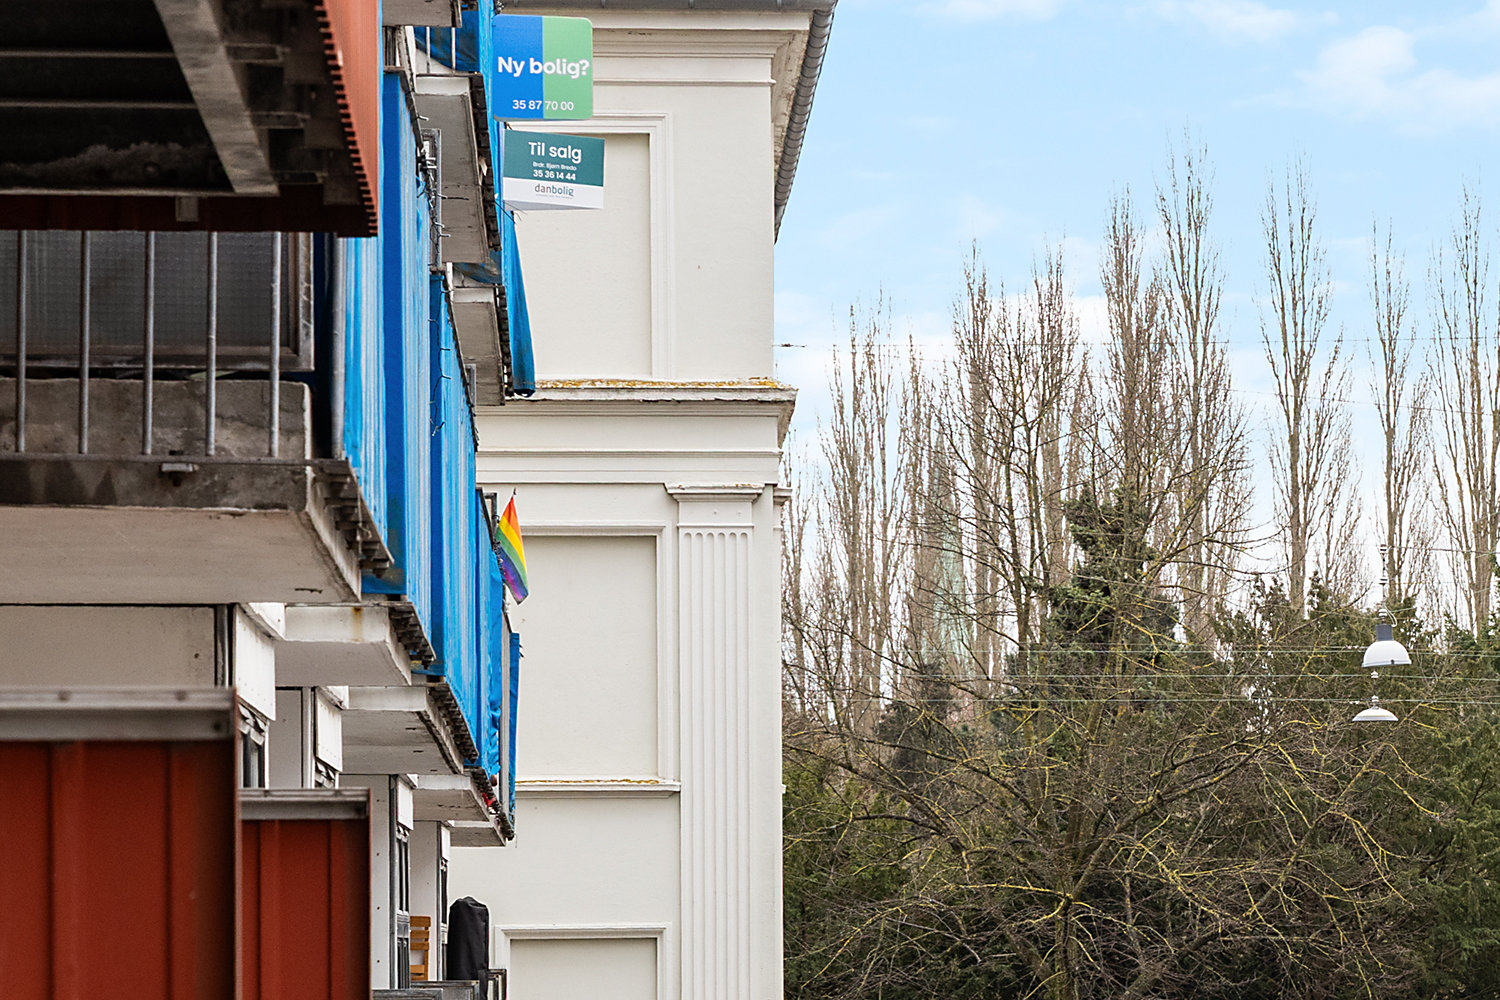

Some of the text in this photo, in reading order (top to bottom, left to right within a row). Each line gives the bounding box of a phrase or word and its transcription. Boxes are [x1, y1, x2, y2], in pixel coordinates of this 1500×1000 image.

[497, 56, 590, 79] Ny bolig?
[512, 100, 574, 111] 35 87 70 00
[528, 141, 582, 164] Til salg
[533, 169, 576, 180] 35 36 14 44
[534, 183, 574, 197] danbolig
